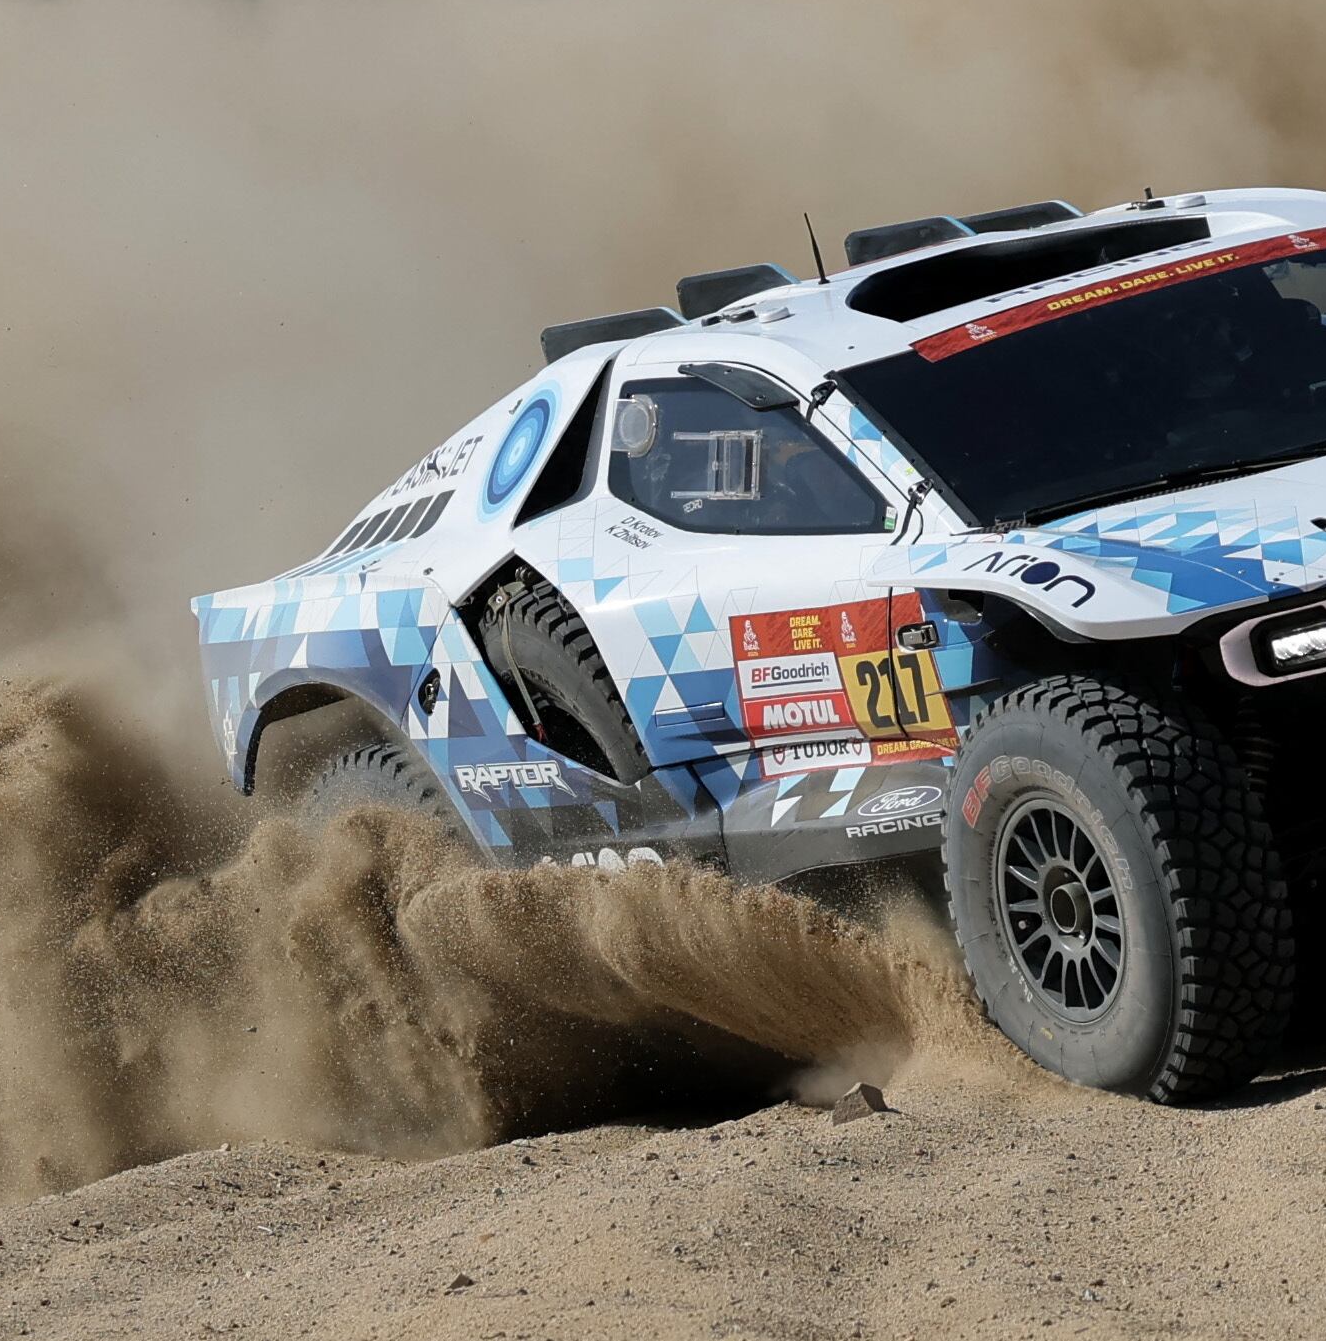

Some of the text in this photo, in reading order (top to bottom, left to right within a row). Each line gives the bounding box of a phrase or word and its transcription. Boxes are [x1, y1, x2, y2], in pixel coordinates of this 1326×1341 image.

[1046, 252, 1240, 311] DREAM. DARE. LIVE IT.
[789, 615, 821, 628] DREAM.
[791, 627, 816, 639] DARE.
[793, 638, 823, 651] LIVE IT.
[751, 662, 830, 684] BFGoodrich
[856, 653, 930, 728] 217
[763, 698, 841, 730] MOTUL
[789, 739, 850, 760] TUDOR
[877, 741, 909, 756] DREAM.
[454, 760, 578, 803] RAPTOR
[871, 790, 927, 813] Ford
[846, 813, 943, 839] RACING
[962, 755, 1133, 890] BFGoodrich
